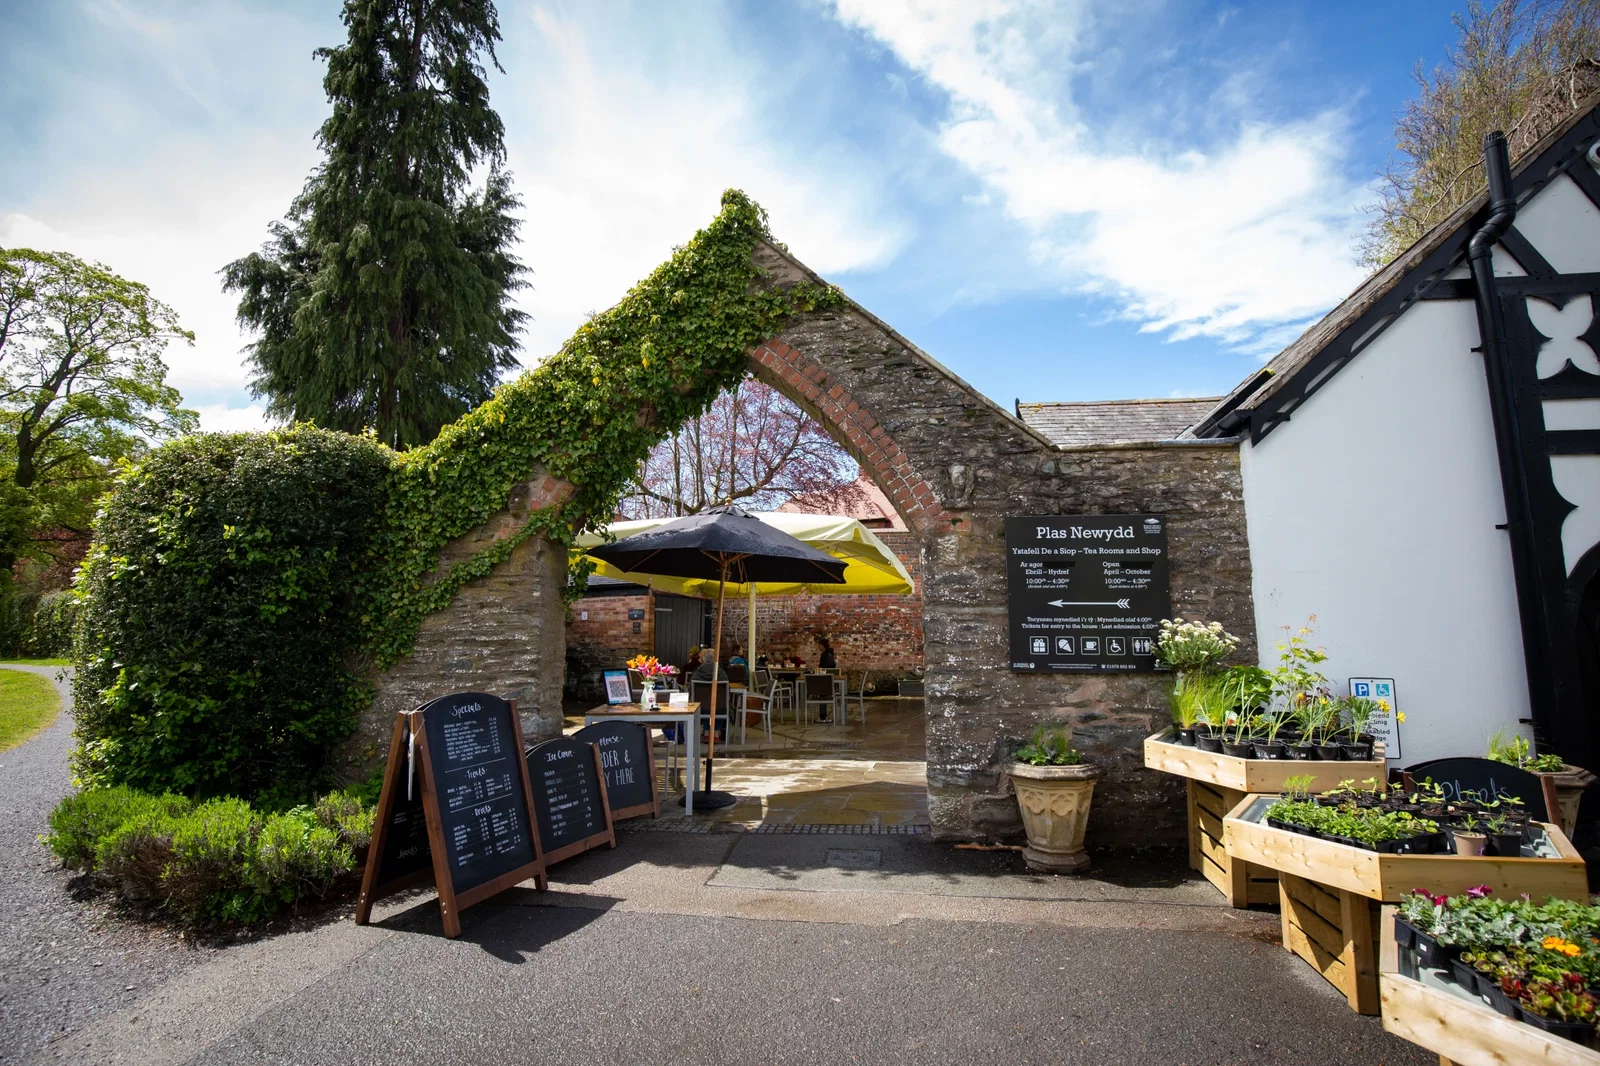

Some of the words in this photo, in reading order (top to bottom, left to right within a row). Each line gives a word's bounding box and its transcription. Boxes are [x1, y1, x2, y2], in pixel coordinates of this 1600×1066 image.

[1036, 526, 1067, 539] Plas
[1070, 526, 1134, 542] Newydd
[1060, 548, 1076, 556] Siop
[1142, 547, 1161, 556] Shop
[452, 702, 481, 718] Specials
[546, 752, 557, 762] Ice
[558, 750, 573, 759] Cream
[600, 750, 620, 768] RDER
[624, 749, 631, 765] &
[467, 767, 486, 779] Treats
[615, 767, 635, 785] HERE
[1440, 778, 1512, 802] Plants
